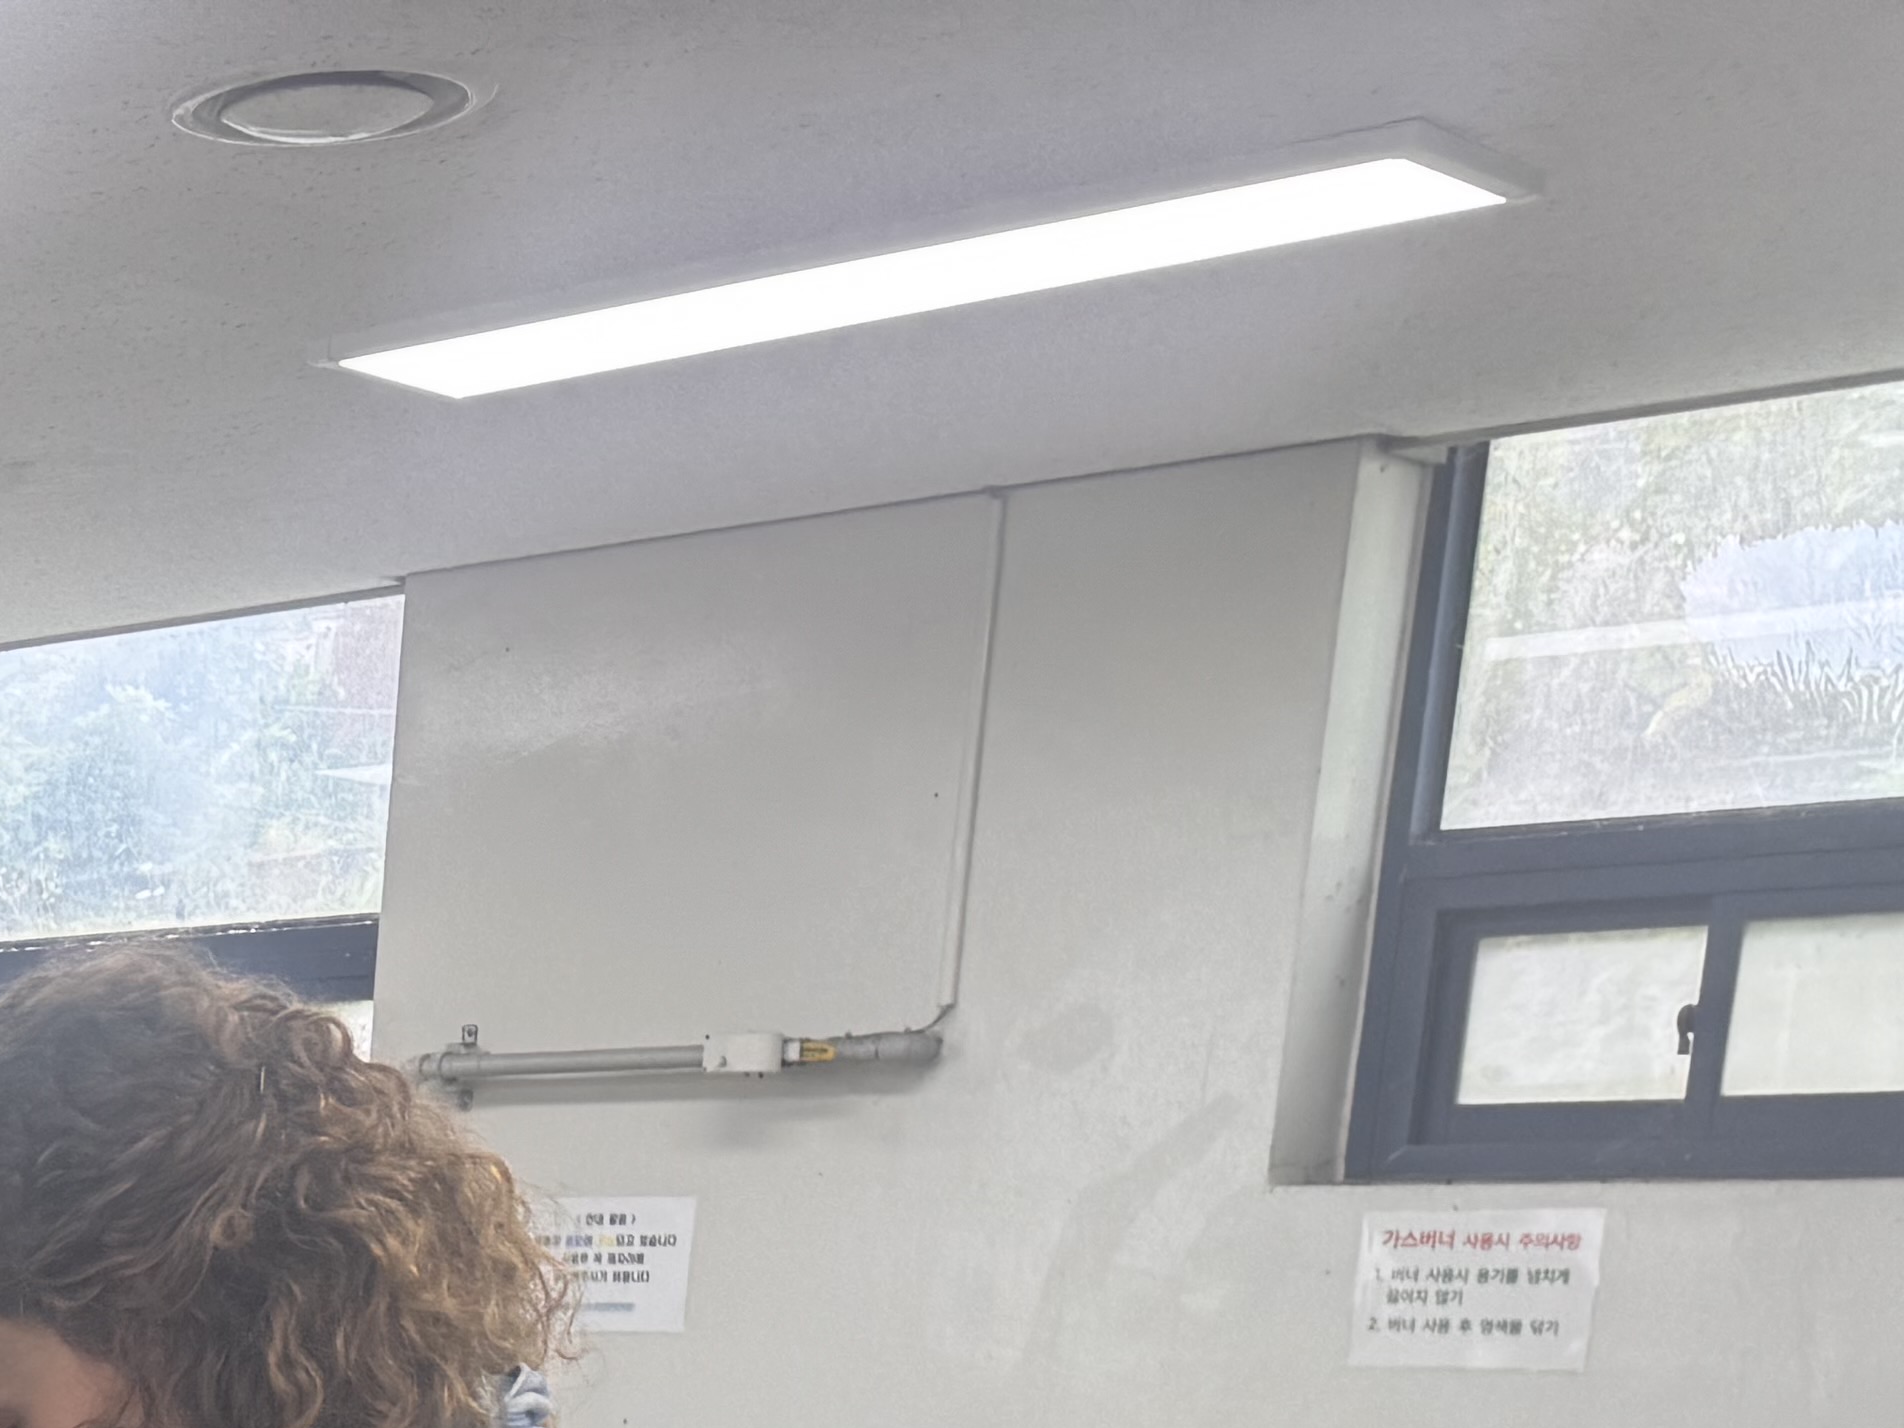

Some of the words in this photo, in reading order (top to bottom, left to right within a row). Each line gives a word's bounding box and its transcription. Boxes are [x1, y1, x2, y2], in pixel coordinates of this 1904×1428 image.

[1382, 1229, 1456, 1250] 가스버너
[1462, 1231, 1511, 1251] 사용시
[1519, 1232, 1583, 1251] 주의사항
